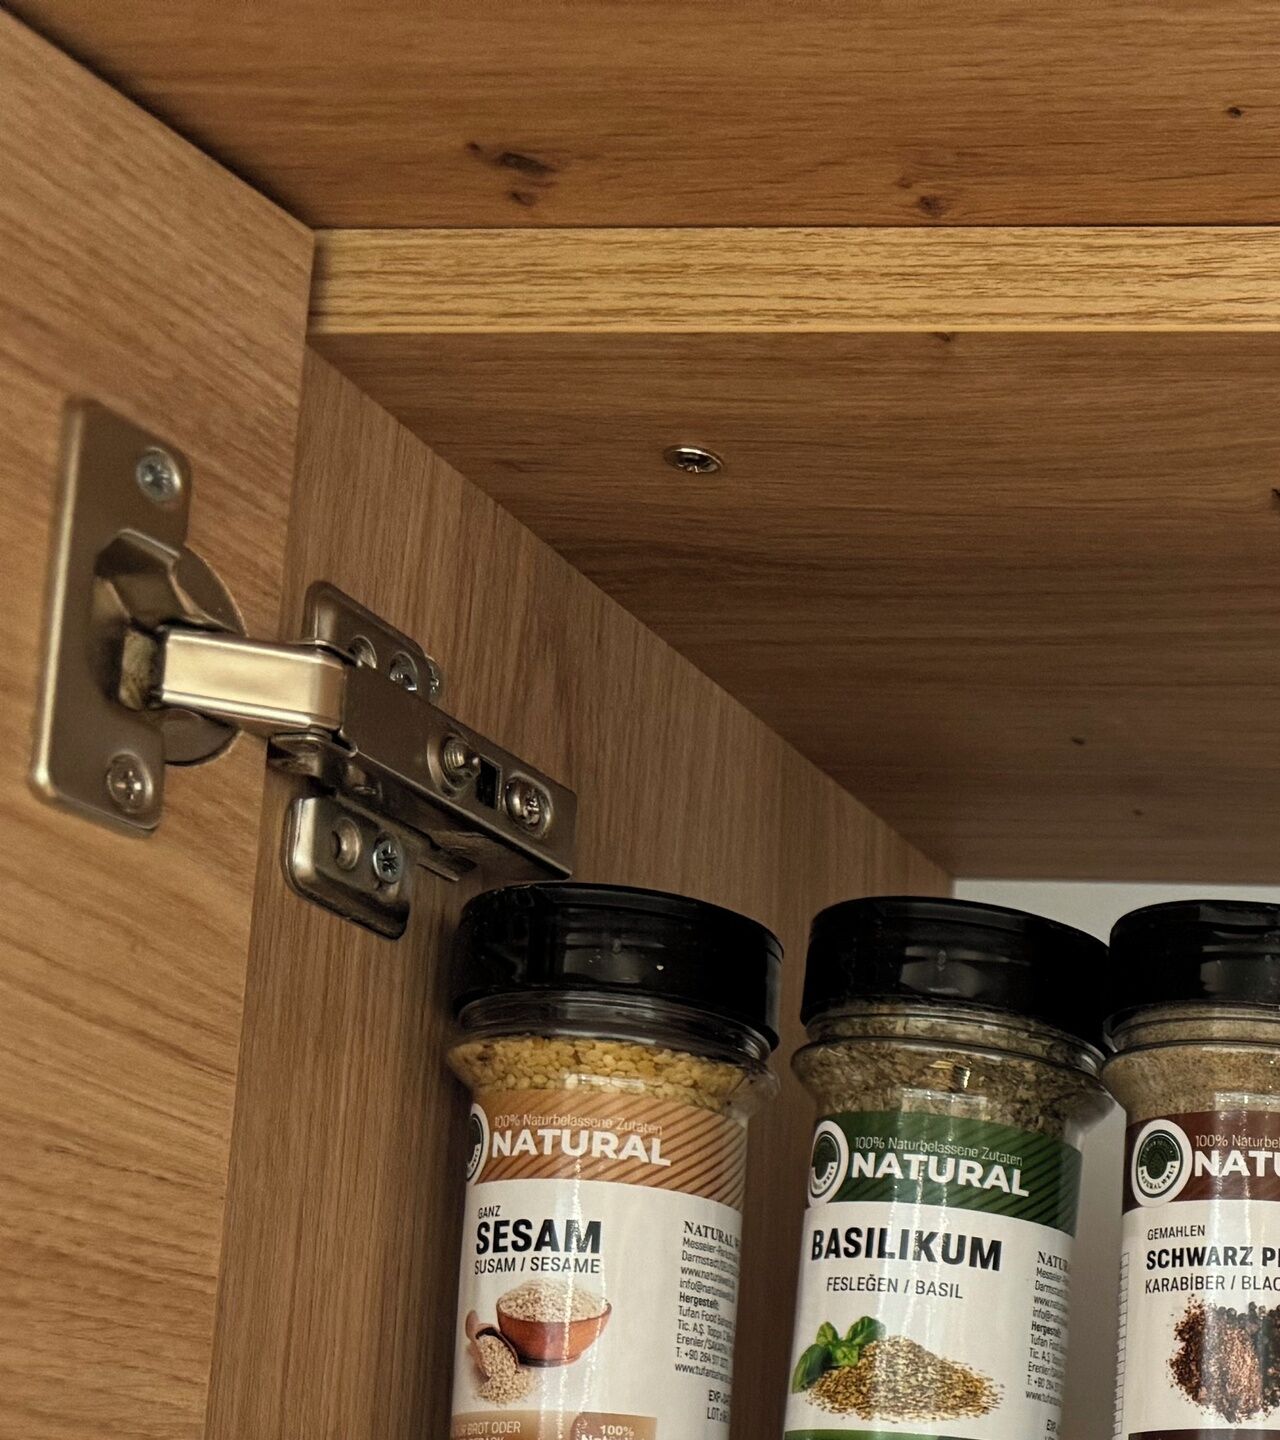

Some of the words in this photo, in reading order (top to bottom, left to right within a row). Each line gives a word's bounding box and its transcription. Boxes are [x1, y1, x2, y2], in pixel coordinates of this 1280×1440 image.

[523, 1113, 614, 1130] Naturbelassene
[617, 1118, 662, 1136] Zutaten
[492, 1129, 671, 1166] NATURAL
[855, 1136, 885, 1150] 100%
[888, 1137, 978, 1158] Naturbelassene
[982, 1147, 1023, 1166] Zutaten
[1195, 1135, 1228, 1148] 100%
[852, 1152, 1030, 1198] NATURAL
[478, 1205, 501, 1219] GANZ
[476, 1219, 602, 1255] SESAM
[684, 1221, 734, 1248] NATURAL
[1148, 1224, 1206, 1241] GEMAHLEN
[811, 1227, 1002, 1271] BASILIKUM
[1146, 1246, 1252, 1270] SCHWARZ
[474, 1257, 516, 1274] SUSAM
[530, 1257, 600, 1274] SESAME
[826, 1273, 898, 1293] FESLEĞEN
[915, 1280, 963, 1299] BASIL
[1145, 1272, 1225, 1294] KARABİBER
[491, 1421, 521, 1434] ODER
[600, 1425, 634, 1436] 100%
